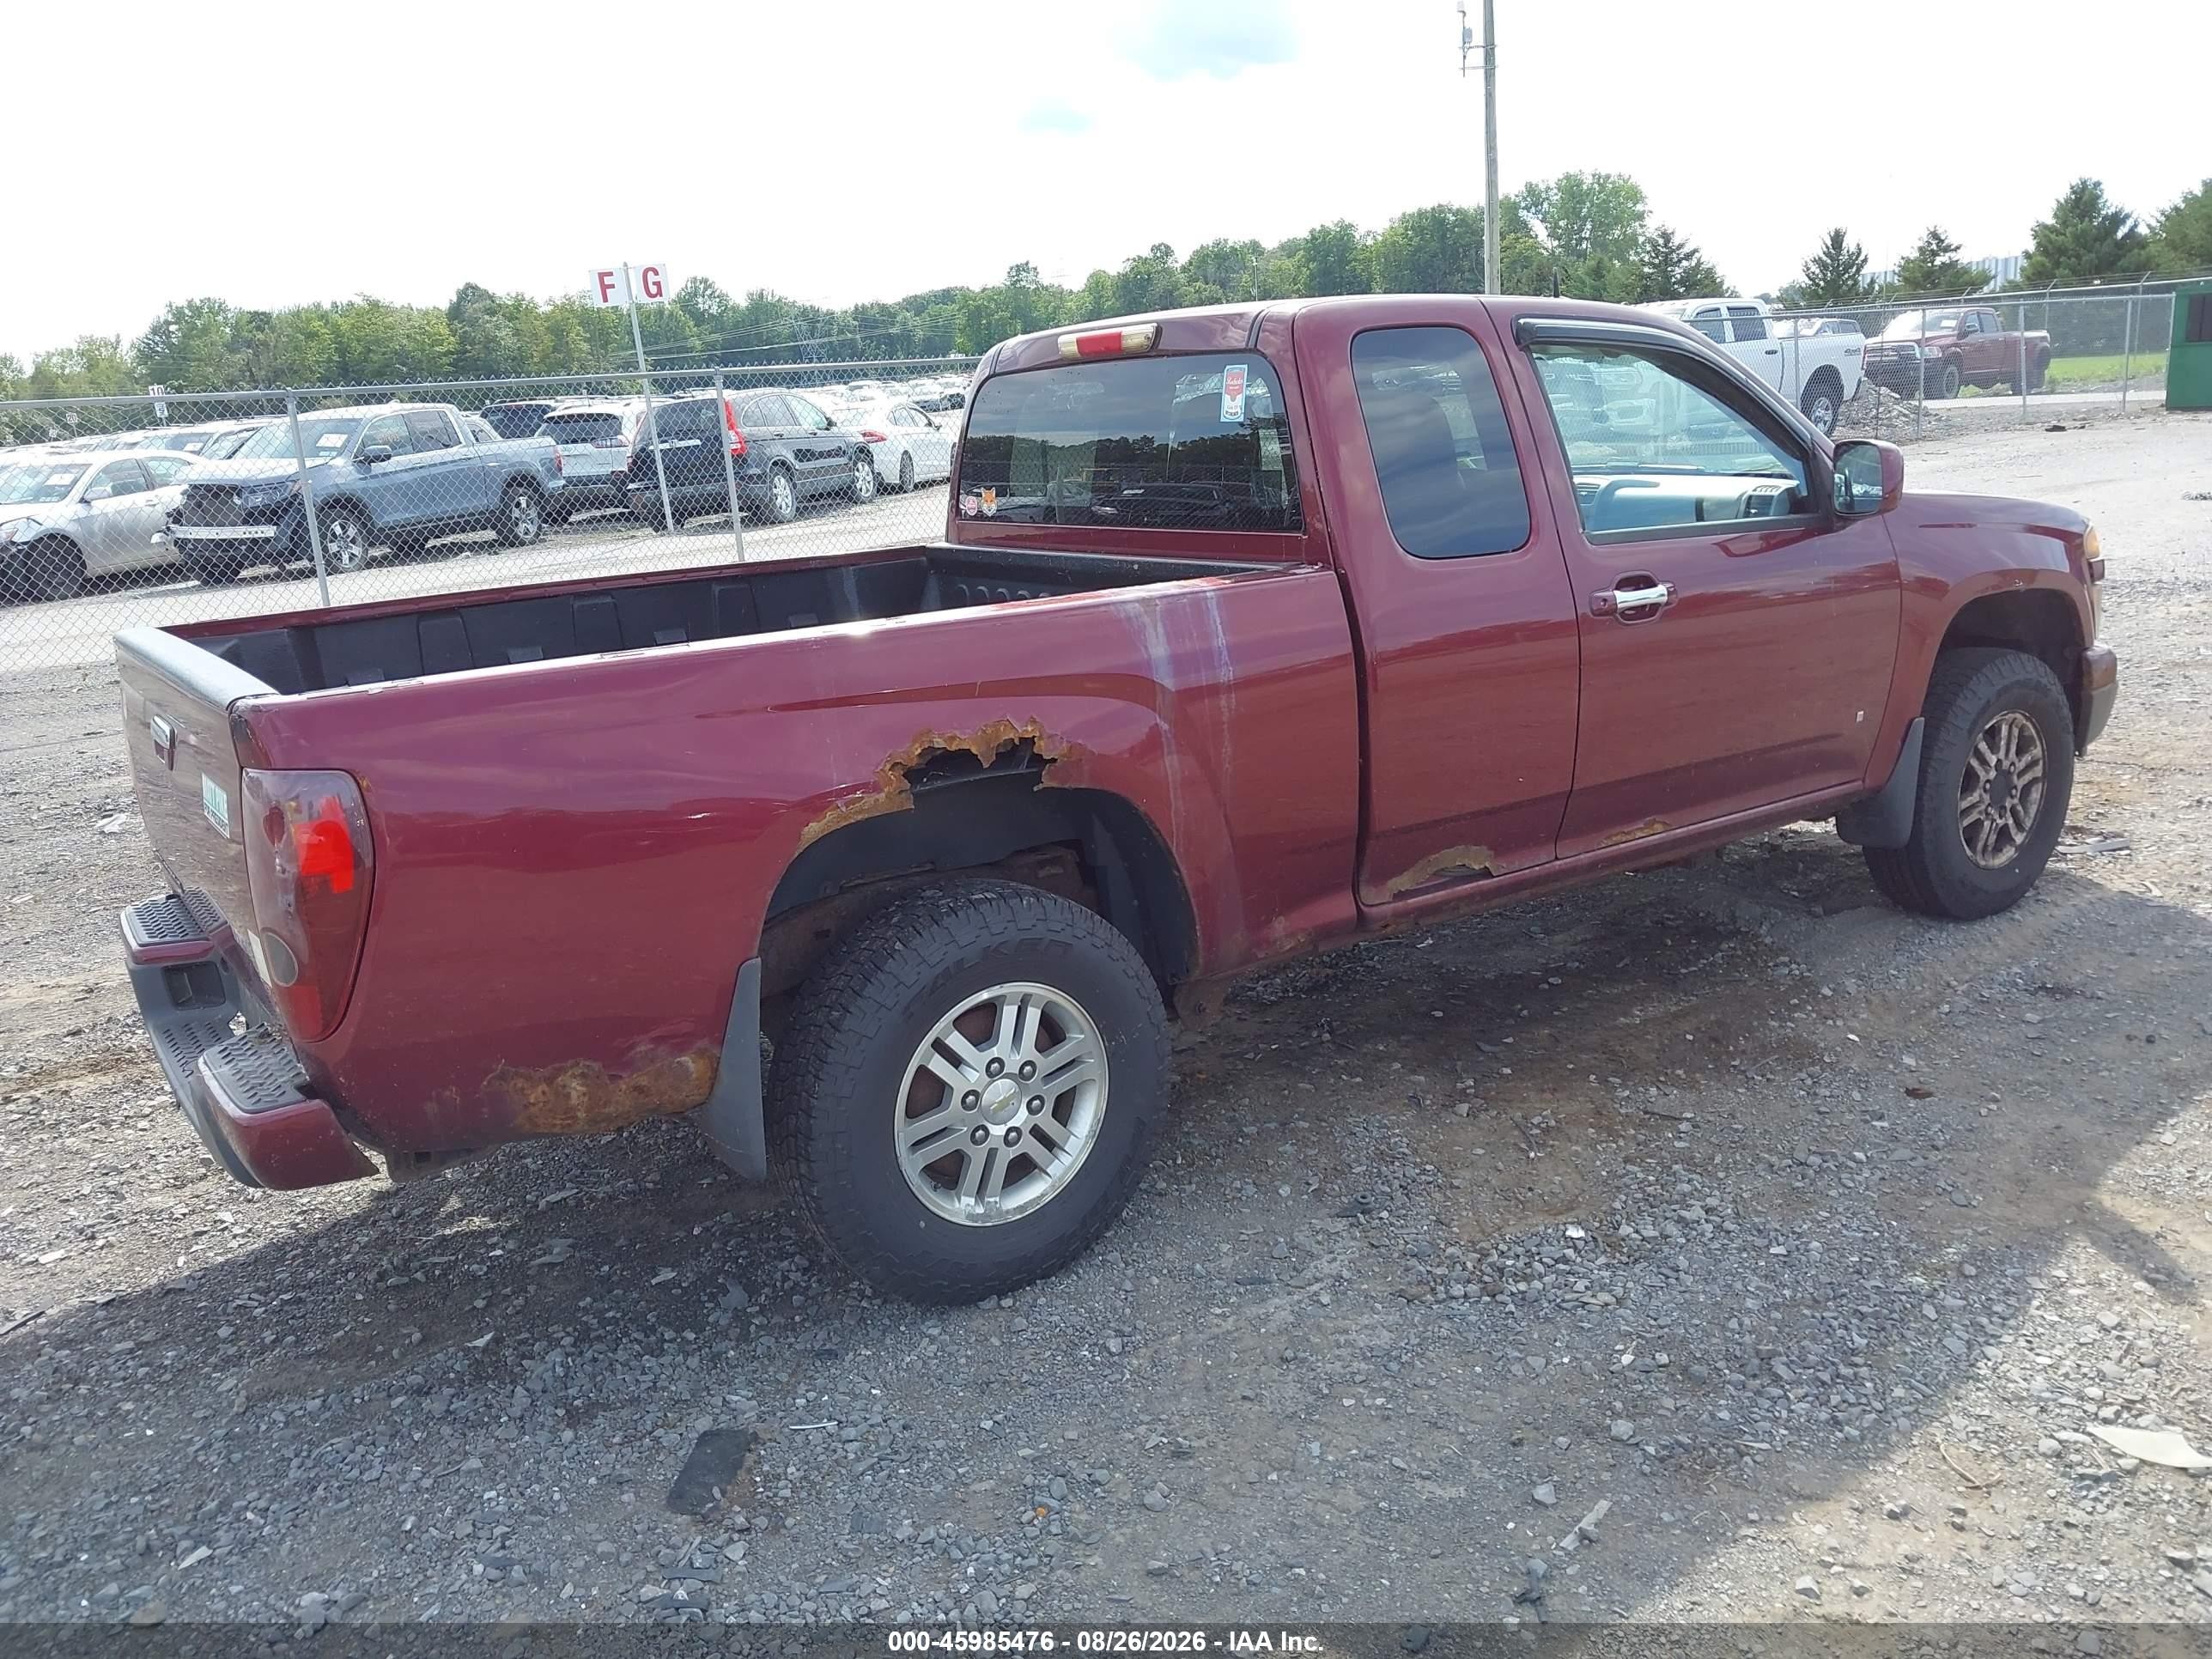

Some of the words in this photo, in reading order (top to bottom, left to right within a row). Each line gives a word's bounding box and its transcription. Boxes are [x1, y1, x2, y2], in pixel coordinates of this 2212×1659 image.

[598, 270, 616, 303] F
[641, 266, 663, 299] G
[149, 386, 163, 396] 10
[68, 413, 76, 422] 20
